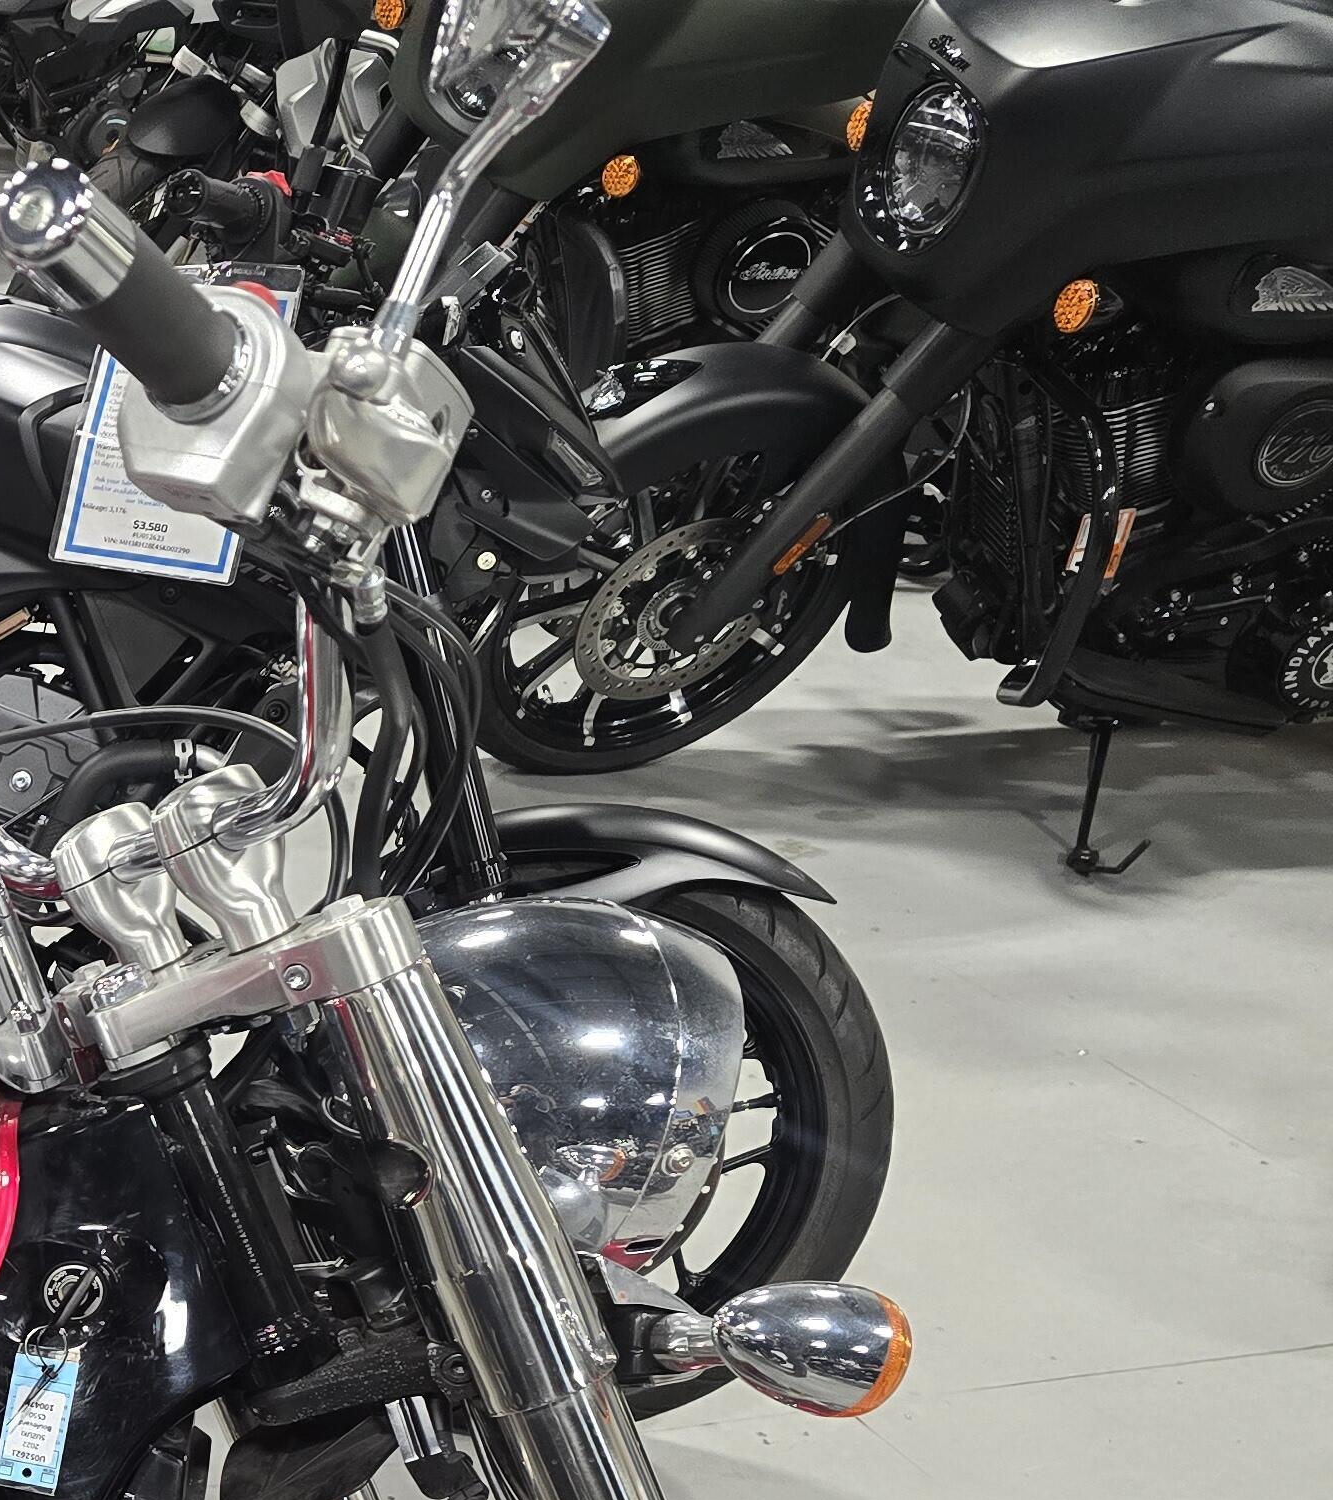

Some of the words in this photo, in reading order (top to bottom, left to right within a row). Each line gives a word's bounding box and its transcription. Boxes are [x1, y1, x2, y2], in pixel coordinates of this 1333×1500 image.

[133, 520, 168, 534] $3,580
[18, 1420, 52, 1432] Boulevard
[21, 1430, 46, 1441] SUZUKI
